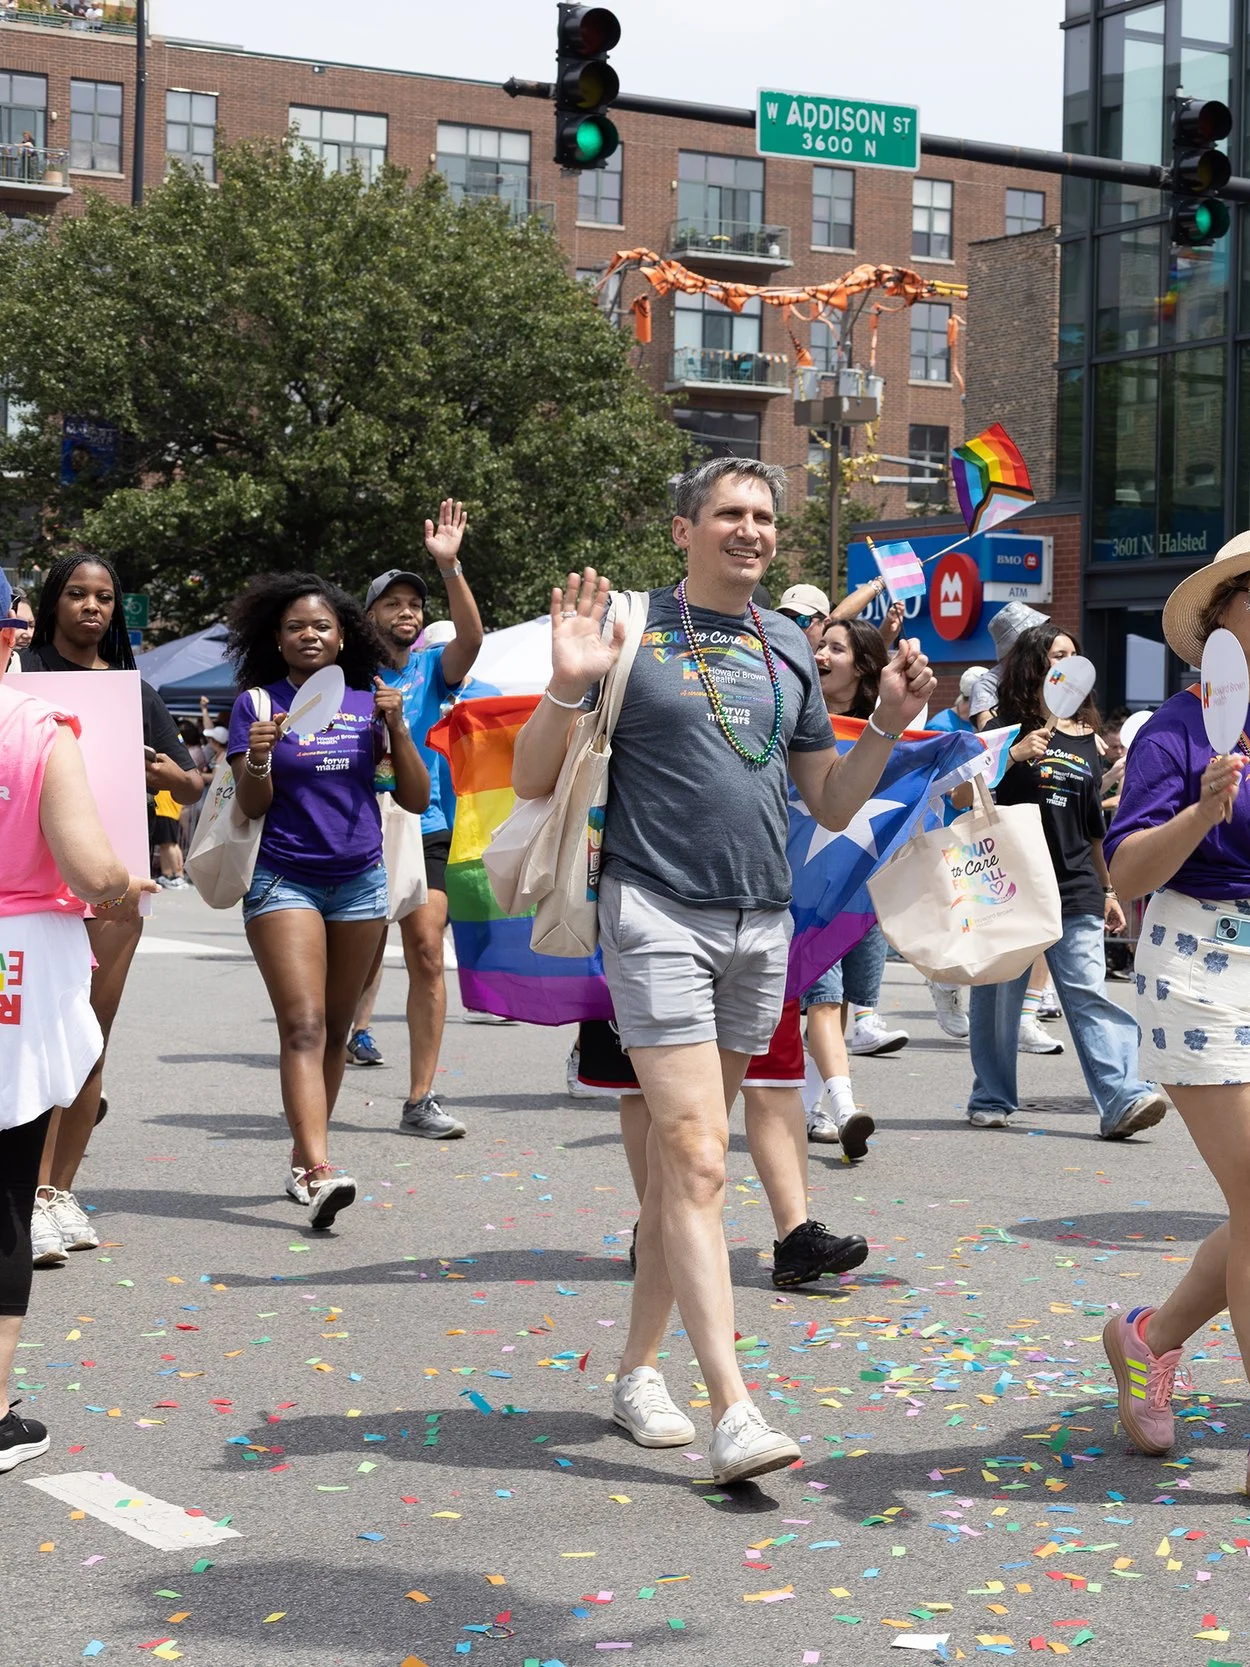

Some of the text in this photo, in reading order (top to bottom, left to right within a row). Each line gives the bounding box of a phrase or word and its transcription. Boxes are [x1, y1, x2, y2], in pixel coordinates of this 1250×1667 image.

[766, 101, 911, 136] W ADDISON ST
[802, 133, 876, 158] 3600 N
[1112, 536, 1139, 557] 3601
[1159, 530, 1208, 553] Halsted
[996, 554, 1022, 566] BMO
[1008, 587, 1028, 598] ATM
[641, 631, 687, 647] PROU
[710, 631, 742, 645] Care
[742, 668, 767, 682] Brown
[720, 706, 751, 718] orvis
[323, 757, 350, 765] forvis
[1054, 749, 1073, 760] Care
[1071, 753, 1086, 765] FOR
[315, 764, 350, 772] mazars
[1069, 772, 1085, 782] Brown
[951, 854, 999, 878] to Care
[981, 867, 1007, 884] ALL
